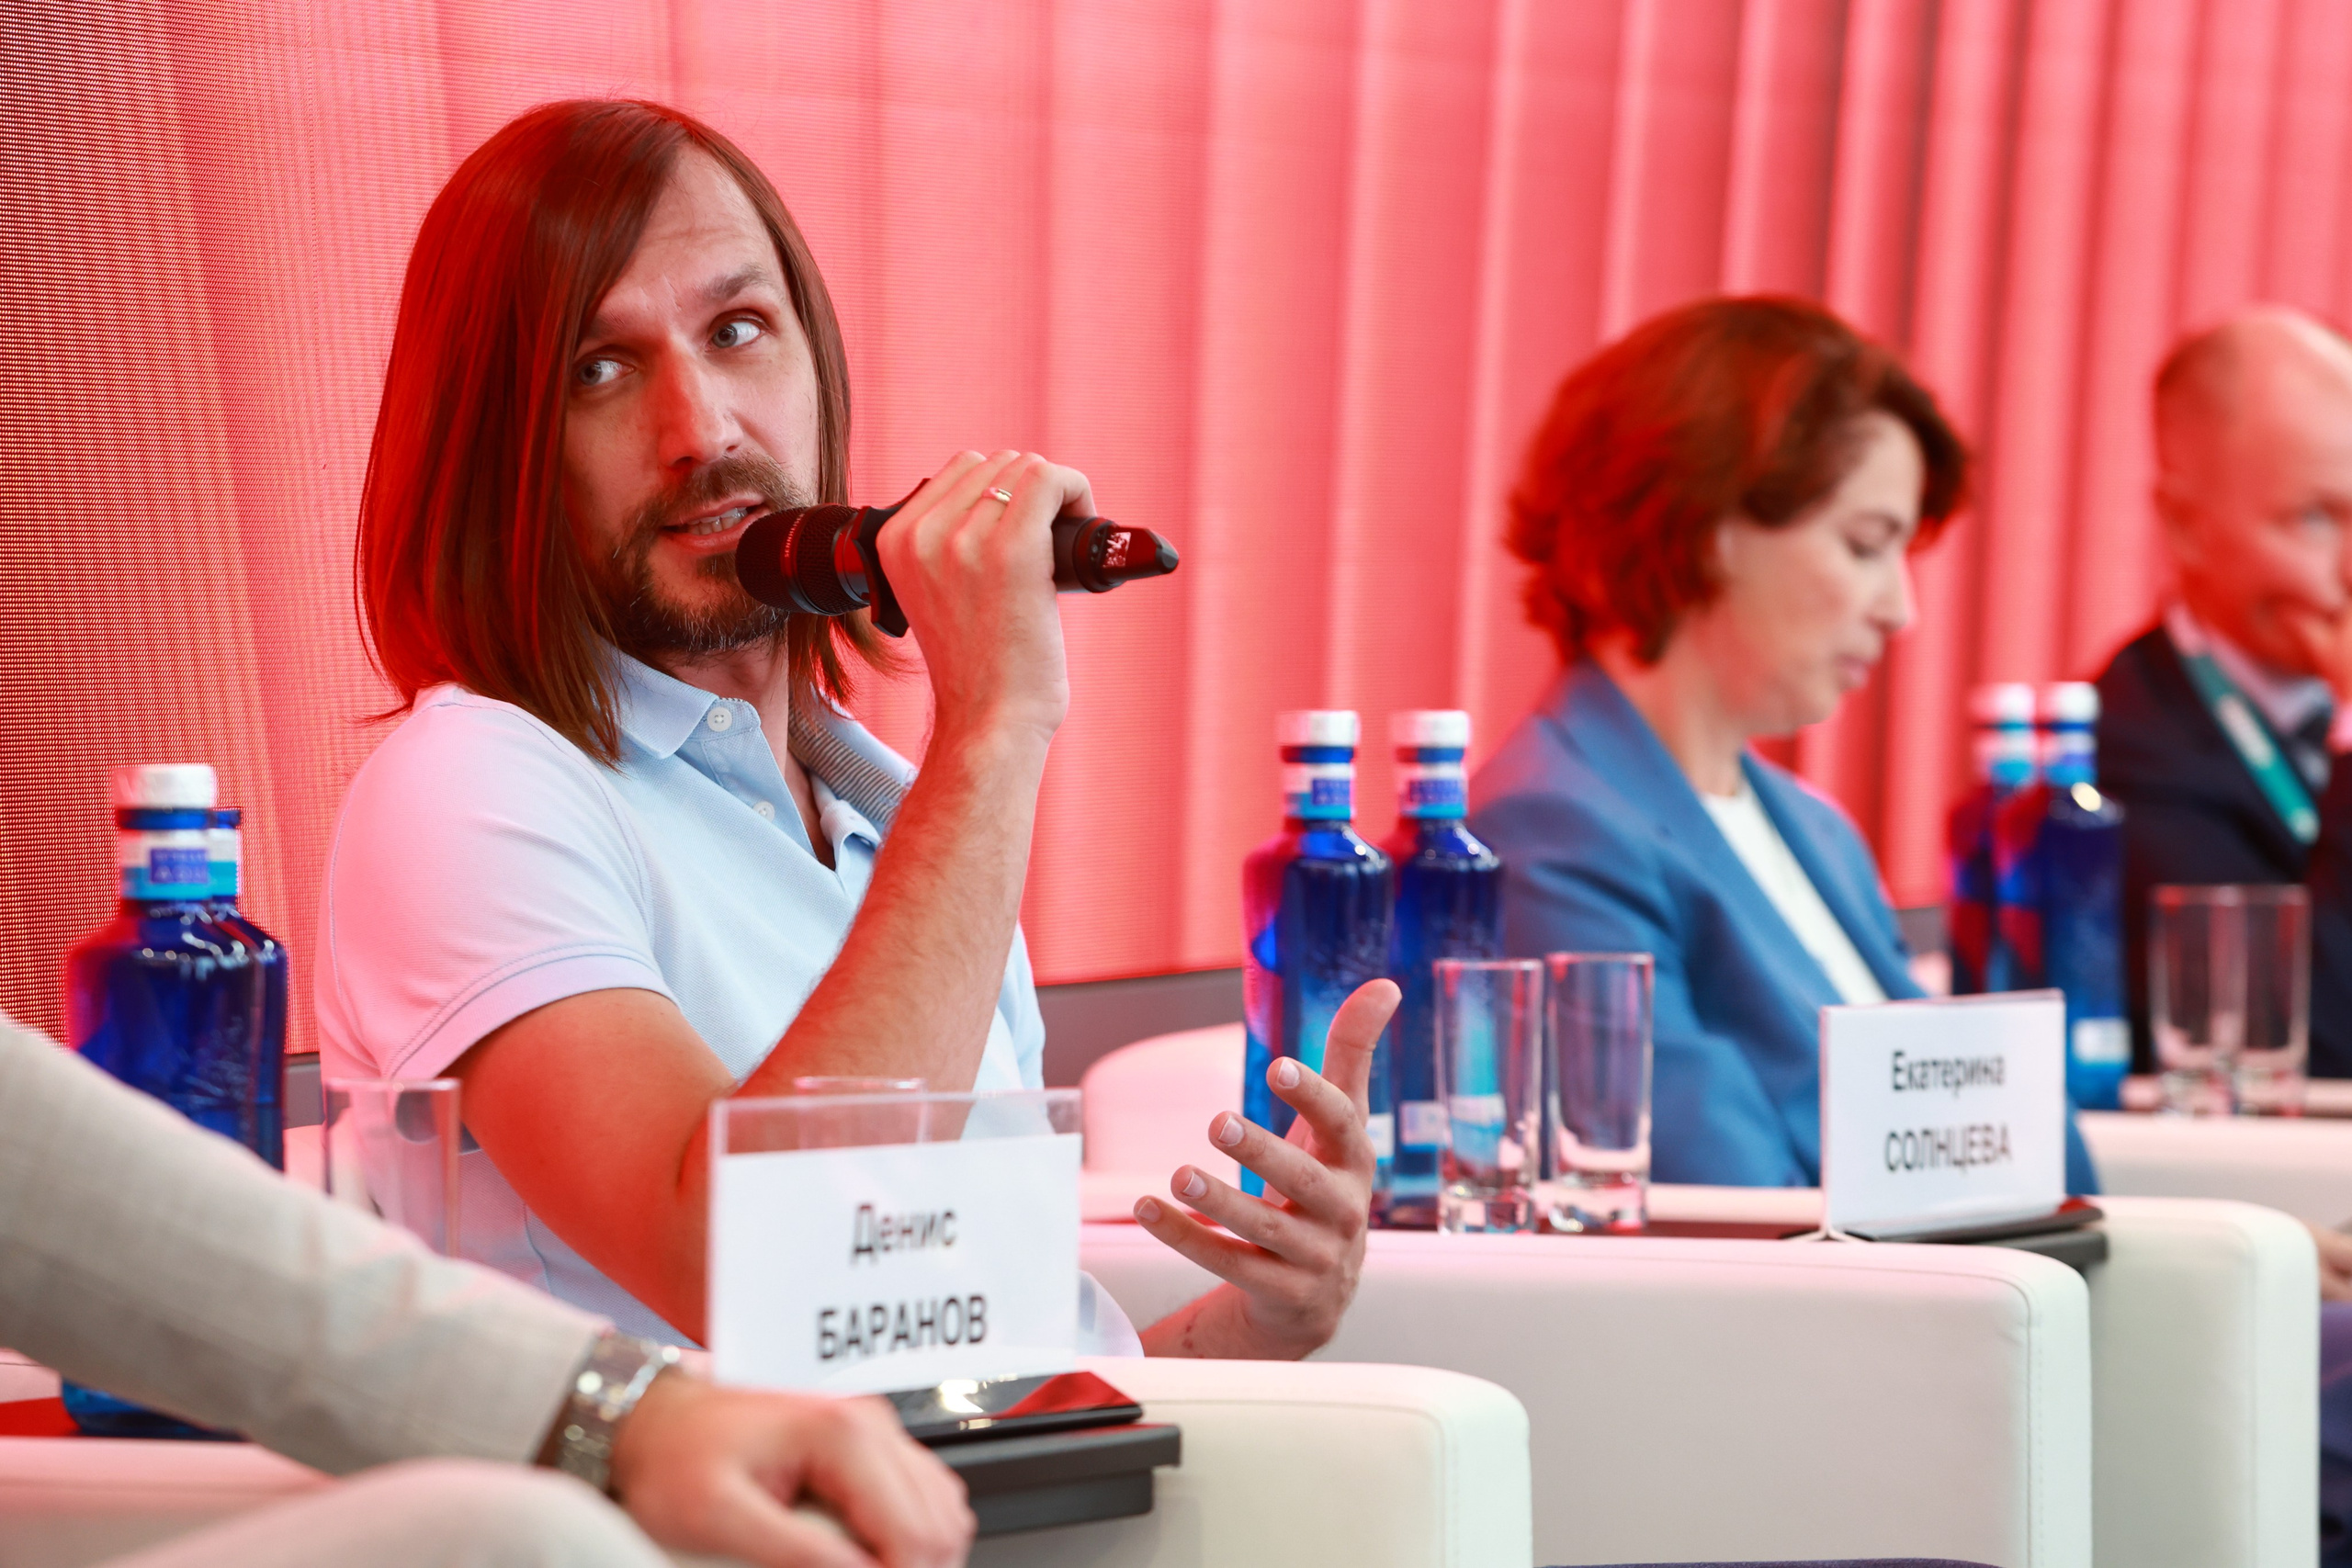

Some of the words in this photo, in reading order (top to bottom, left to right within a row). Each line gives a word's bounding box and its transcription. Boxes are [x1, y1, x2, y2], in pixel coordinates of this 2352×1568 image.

[1891, 1050, 2006, 1099] Екатерина
[1883, 1122, 2012, 1176] СОЛНЦЕВА
[851, 1202, 957, 1265] Денис
[816, 1293, 988, 1362] БАРАНОВ
